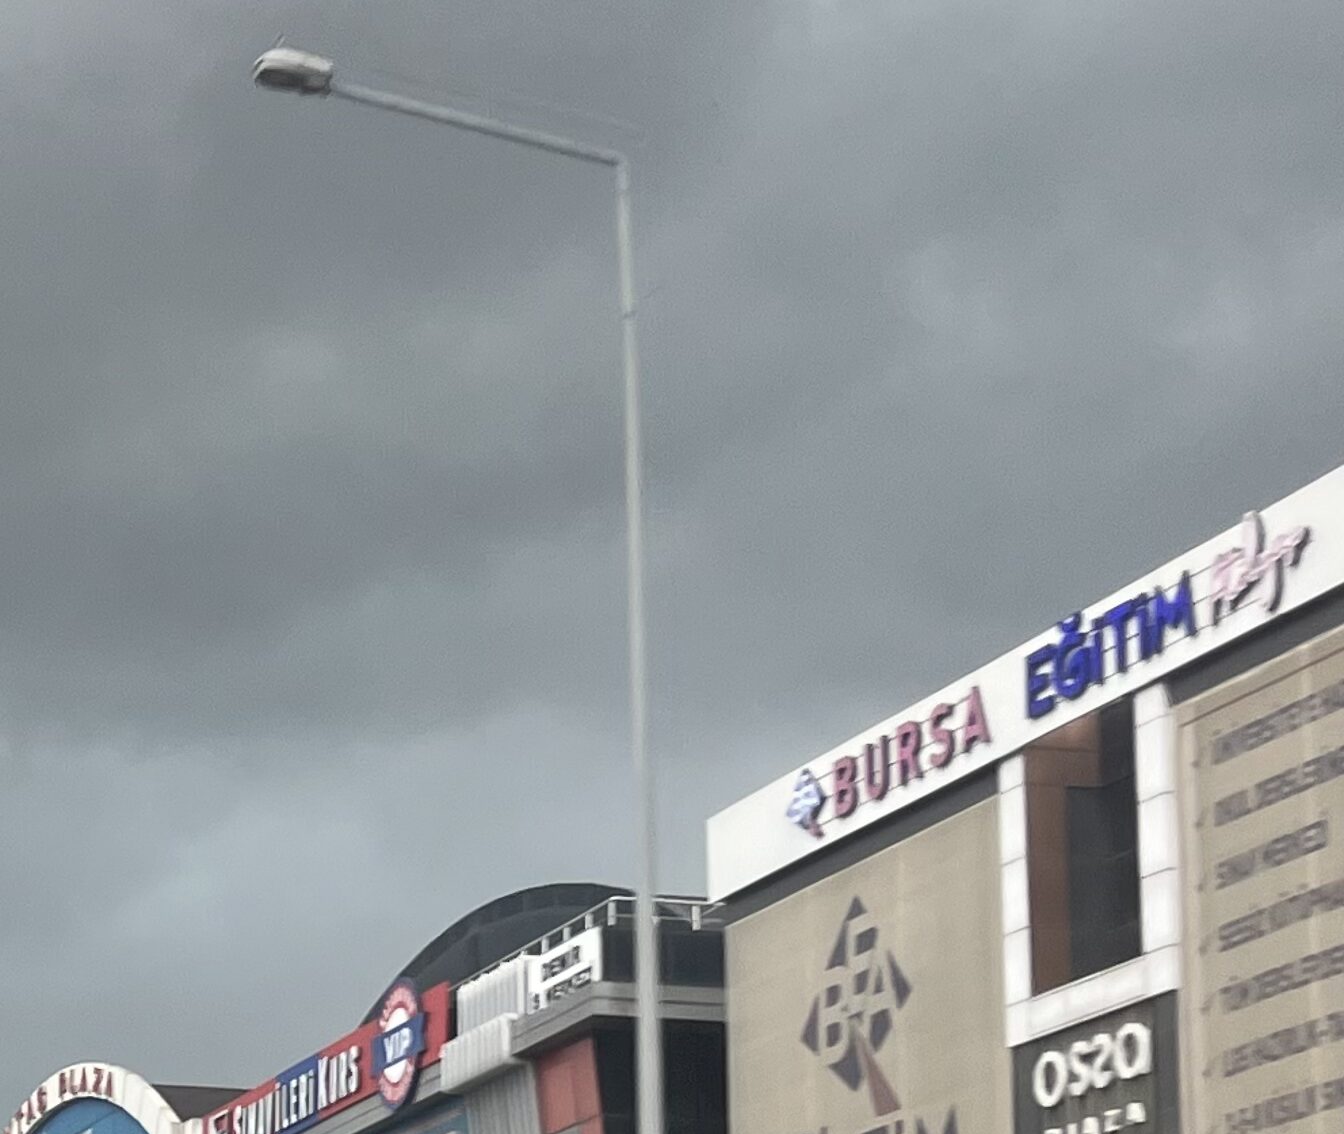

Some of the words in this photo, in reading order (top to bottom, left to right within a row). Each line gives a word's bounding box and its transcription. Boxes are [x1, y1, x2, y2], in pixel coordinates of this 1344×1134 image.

[834, 686, 991, 819] BURSA
[1026, 570, 1198, 720] EĞİTİM
[58, 1066, 114, 1099] PLAZA
